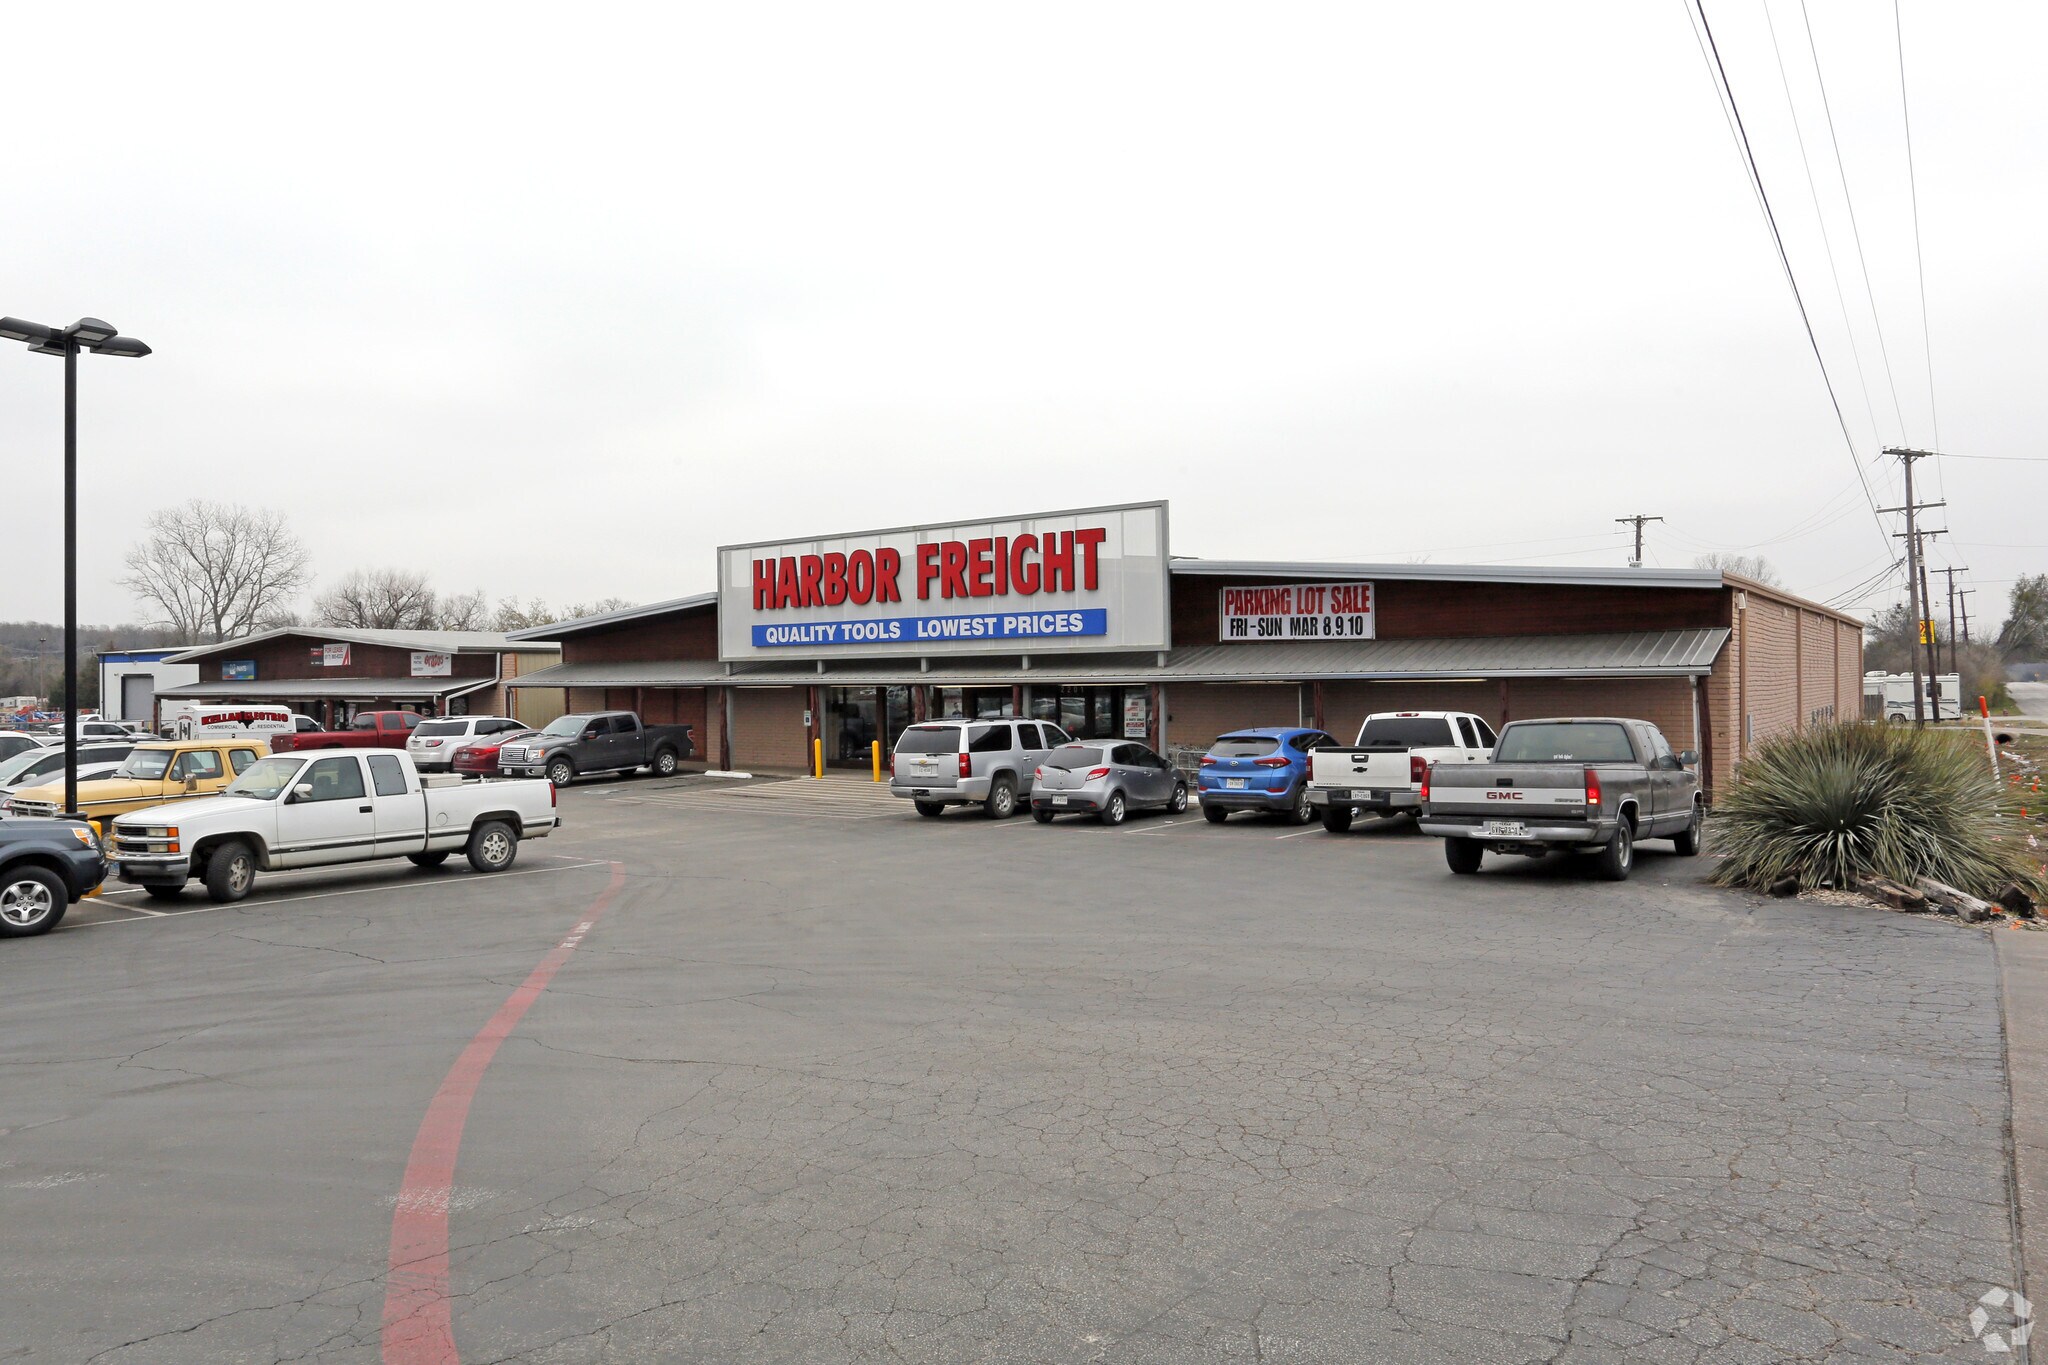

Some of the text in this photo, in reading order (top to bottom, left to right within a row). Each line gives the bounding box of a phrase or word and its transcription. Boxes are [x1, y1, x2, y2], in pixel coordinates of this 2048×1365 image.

[753, 527, 1106, 610] HARBOR FREIGHT
[1225, 584, 1371, 616] PARKING LOT SALE
[766, 613, 1084, 644] QUALITY TOOLS LOWEST PRICES
[1290, 616, 1318, 636] MAR
[1487, 791, 1523, 800] GMC
